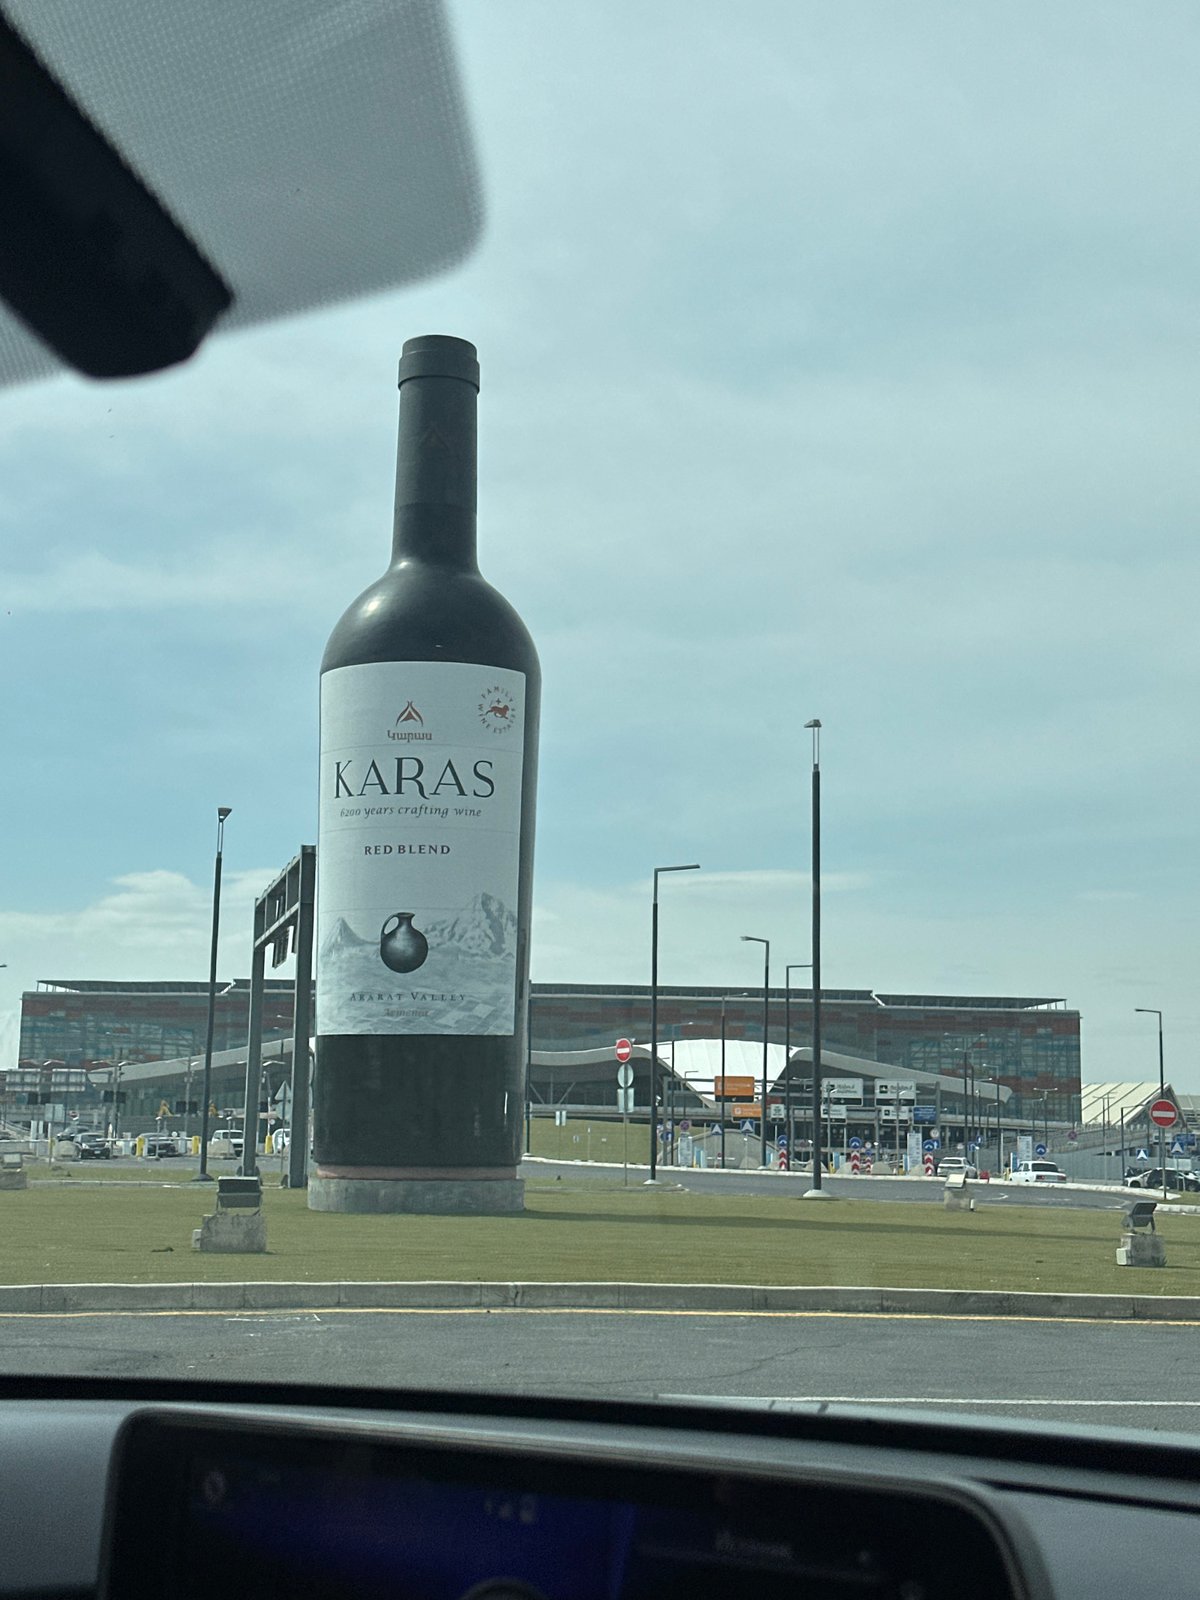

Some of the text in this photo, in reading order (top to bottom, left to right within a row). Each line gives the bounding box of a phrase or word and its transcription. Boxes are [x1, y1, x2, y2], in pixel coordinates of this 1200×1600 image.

[334, 757, 495, 800] KARAS
[340, 804, 482, 819] 6200 years crafting wine
[364, 844, 451, 855] RED BLEND
